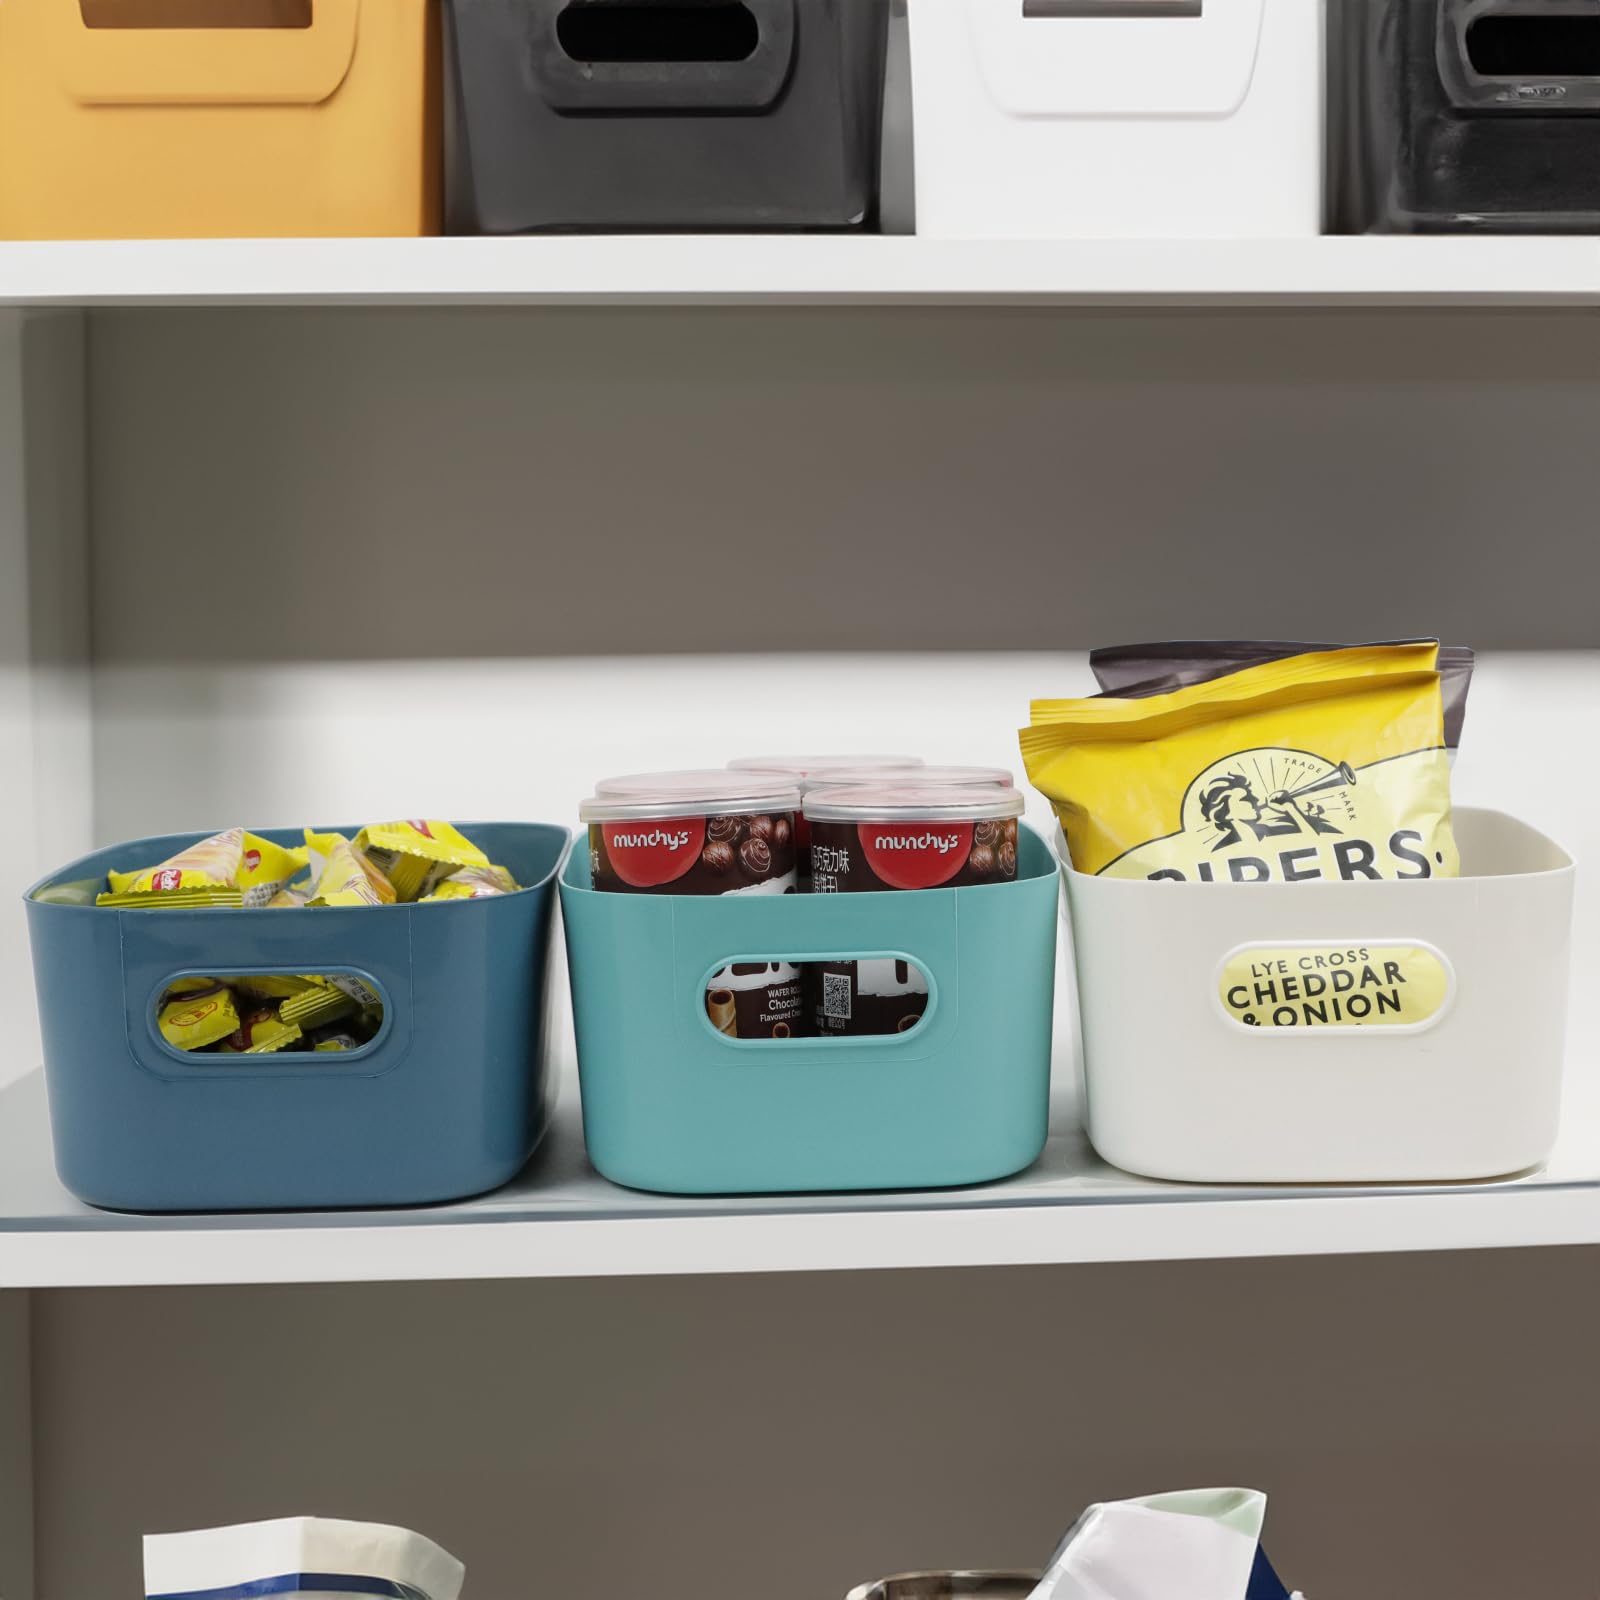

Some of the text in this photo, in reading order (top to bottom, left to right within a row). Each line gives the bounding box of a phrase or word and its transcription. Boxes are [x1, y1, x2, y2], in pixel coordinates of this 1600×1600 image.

[1284, 757, 1322, 774] TRADE
[1338, 791, 1356, 821] MARK
[613, 830, 689, 851] munchy's
[875, 832, 959, 854] munchy's
[1147, 830, 1432, 882] PERS
[1250, 948, 1369, 978] LYE CROSS
[767, 987, 790, 999] WAFER
[1227, 961, 1407, 1009] CHEDDAR
[759, 1010, 791, 1022] Flavoured
[1272, 989, 1402, 1026] ONION
